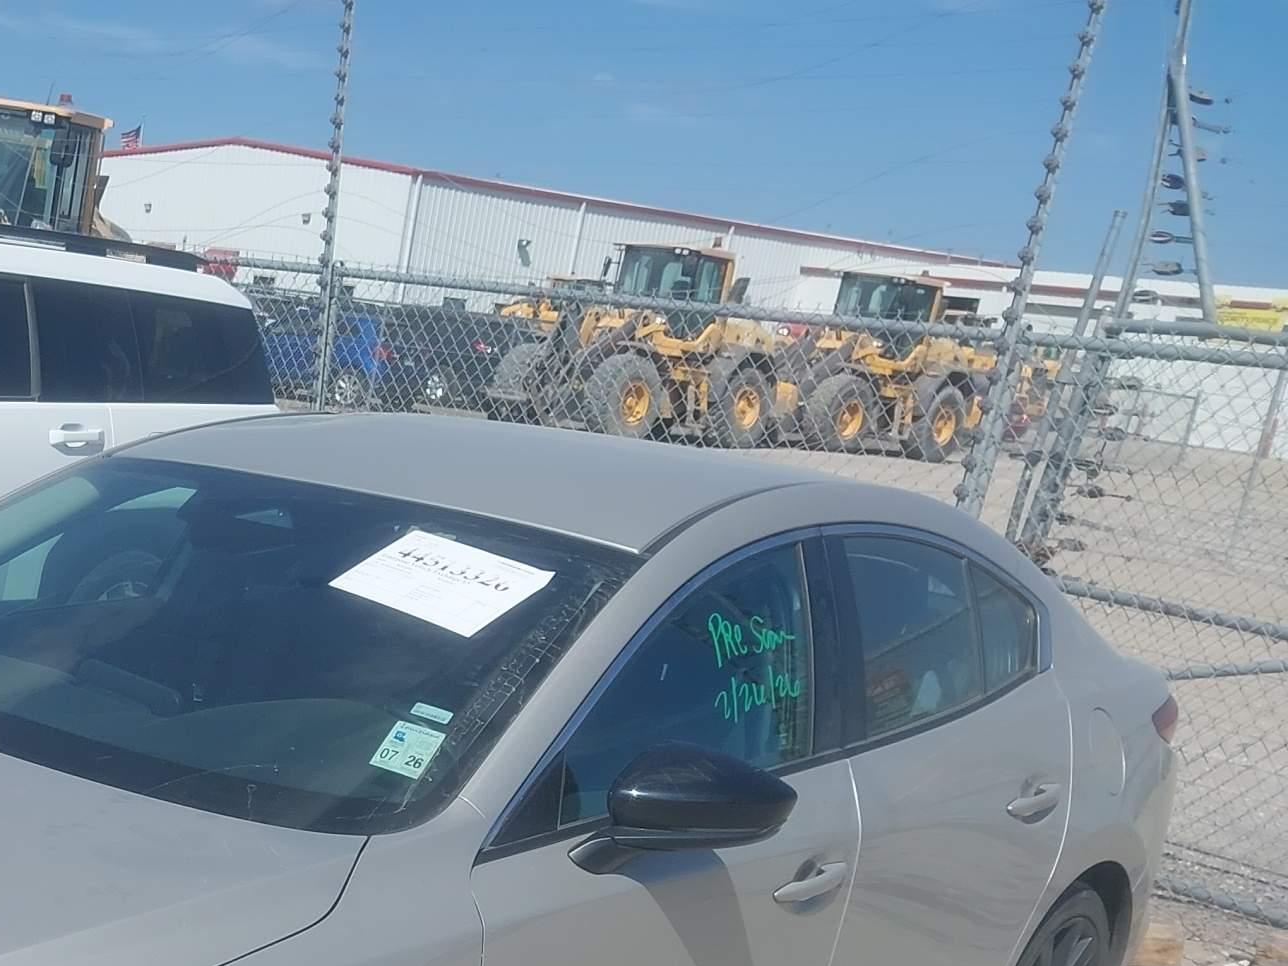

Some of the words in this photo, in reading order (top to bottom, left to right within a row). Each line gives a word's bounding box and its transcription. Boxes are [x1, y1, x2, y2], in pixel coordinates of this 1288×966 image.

[398, 546, 511, 592] 44513326
[379, 747, 399, 761] 07
[404, 754, 425, 769] 26
